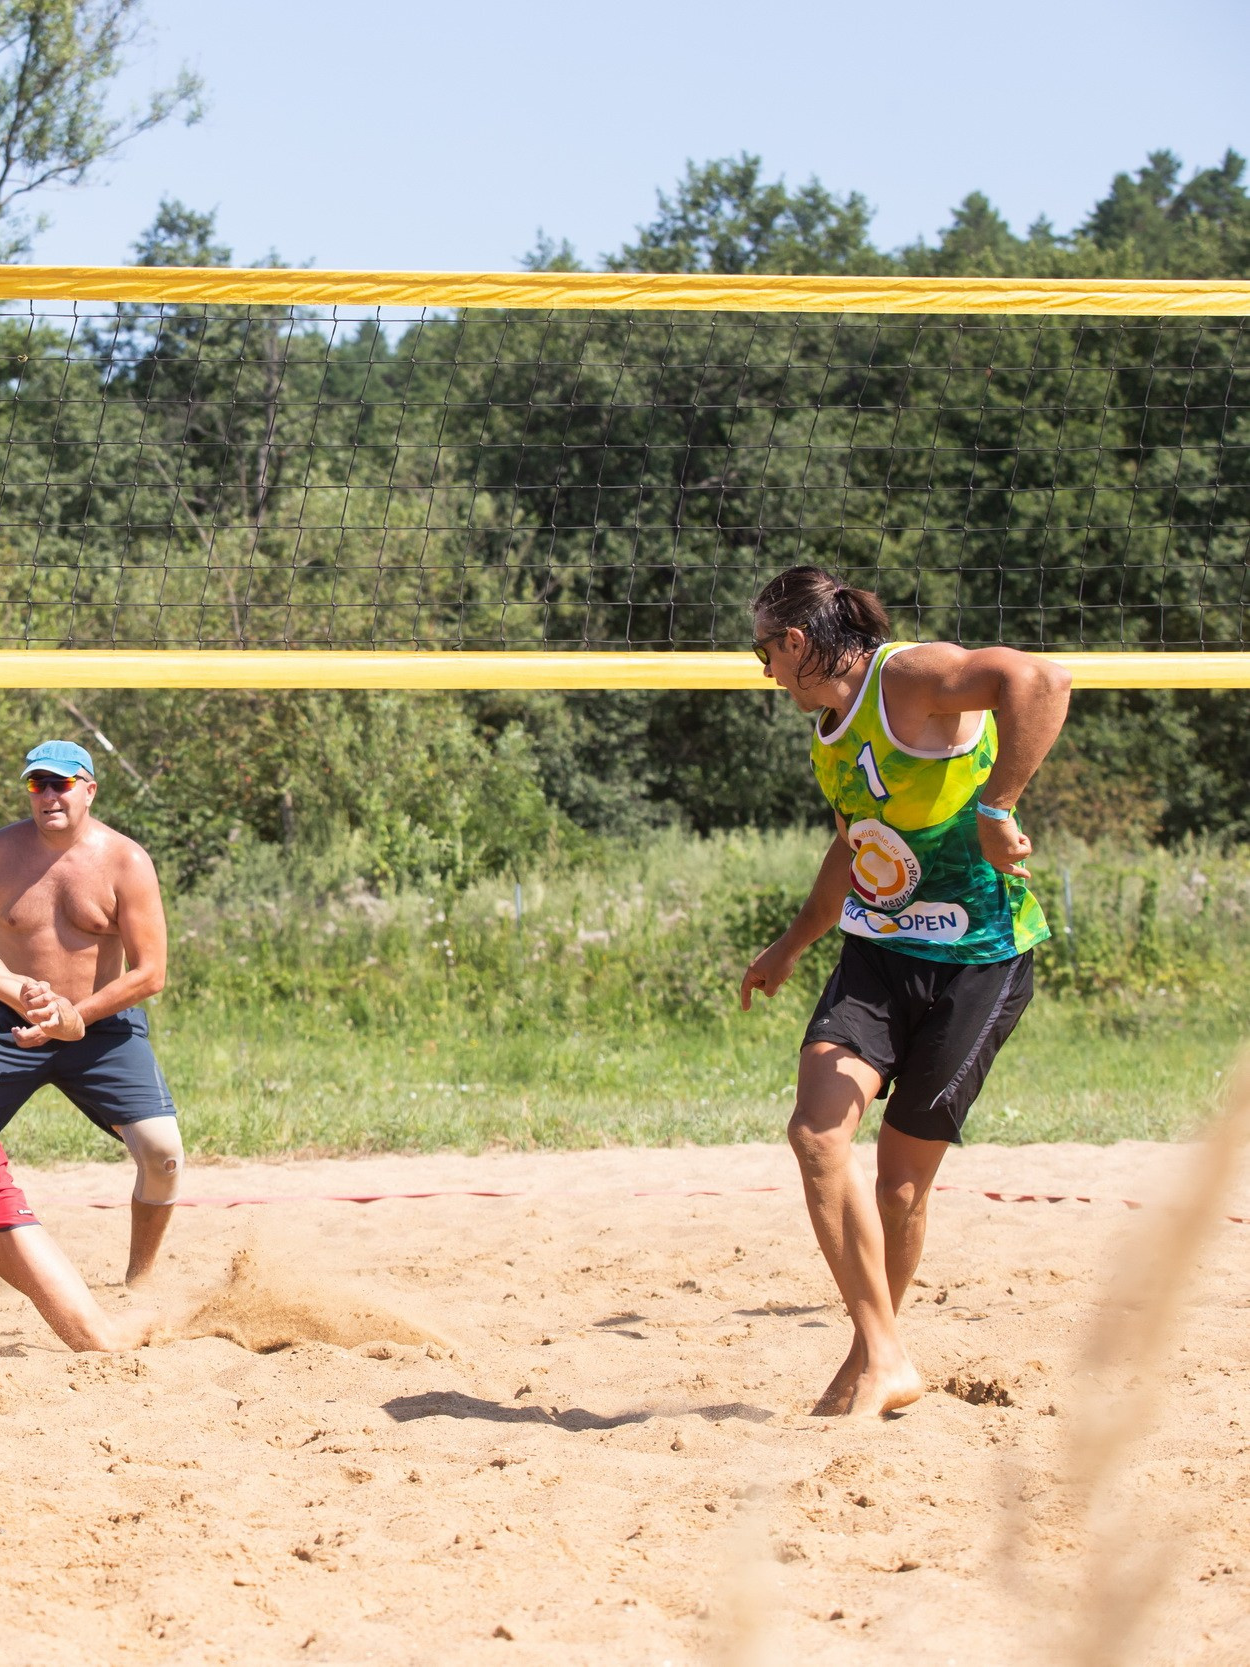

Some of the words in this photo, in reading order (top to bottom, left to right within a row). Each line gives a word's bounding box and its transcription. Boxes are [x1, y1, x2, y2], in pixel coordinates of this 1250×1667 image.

[856, 741, 890, 801] 1
[880, 857, 918, 909] медиа-траст
[843, 899, 865, 921] TULA
[897, 911, 957, 931] OPEN
